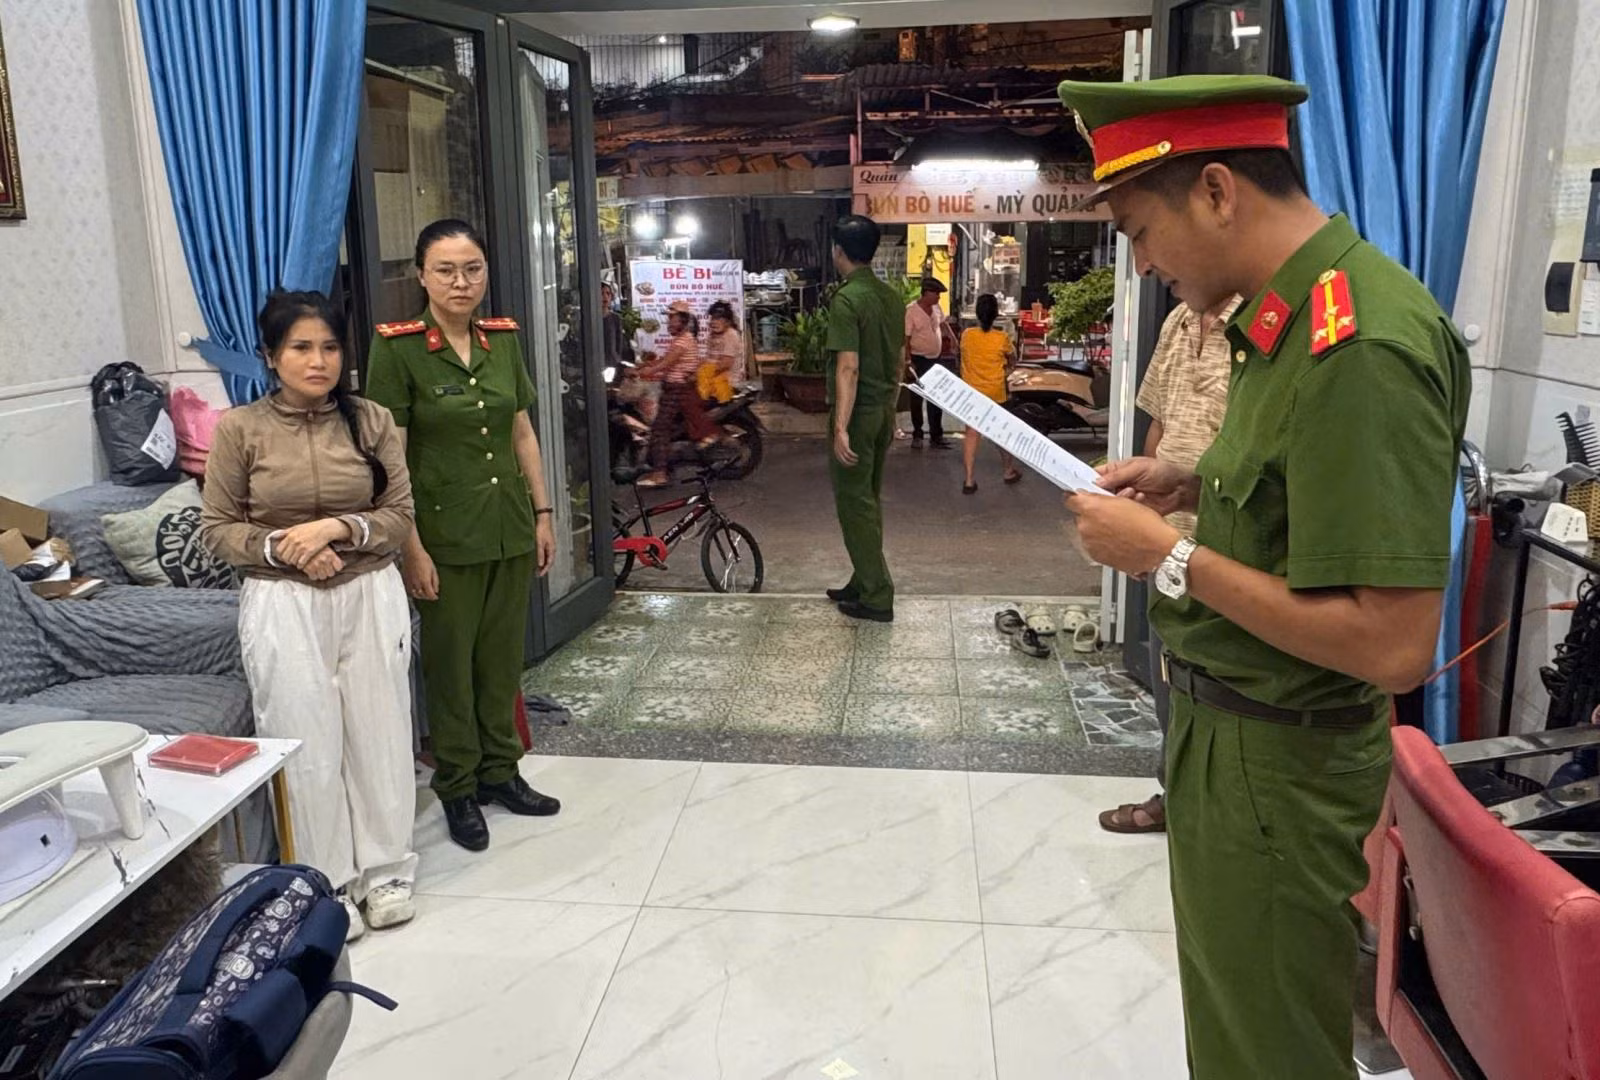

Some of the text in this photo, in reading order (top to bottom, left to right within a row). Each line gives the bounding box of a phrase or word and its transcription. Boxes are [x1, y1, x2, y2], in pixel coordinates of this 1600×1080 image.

[905, 191, 931, 213] BÒ
[938, 187, 977, 214] HUẾ
[996, 190, 1025, 214] MỲ
[694, 268, 712, 279] BI
